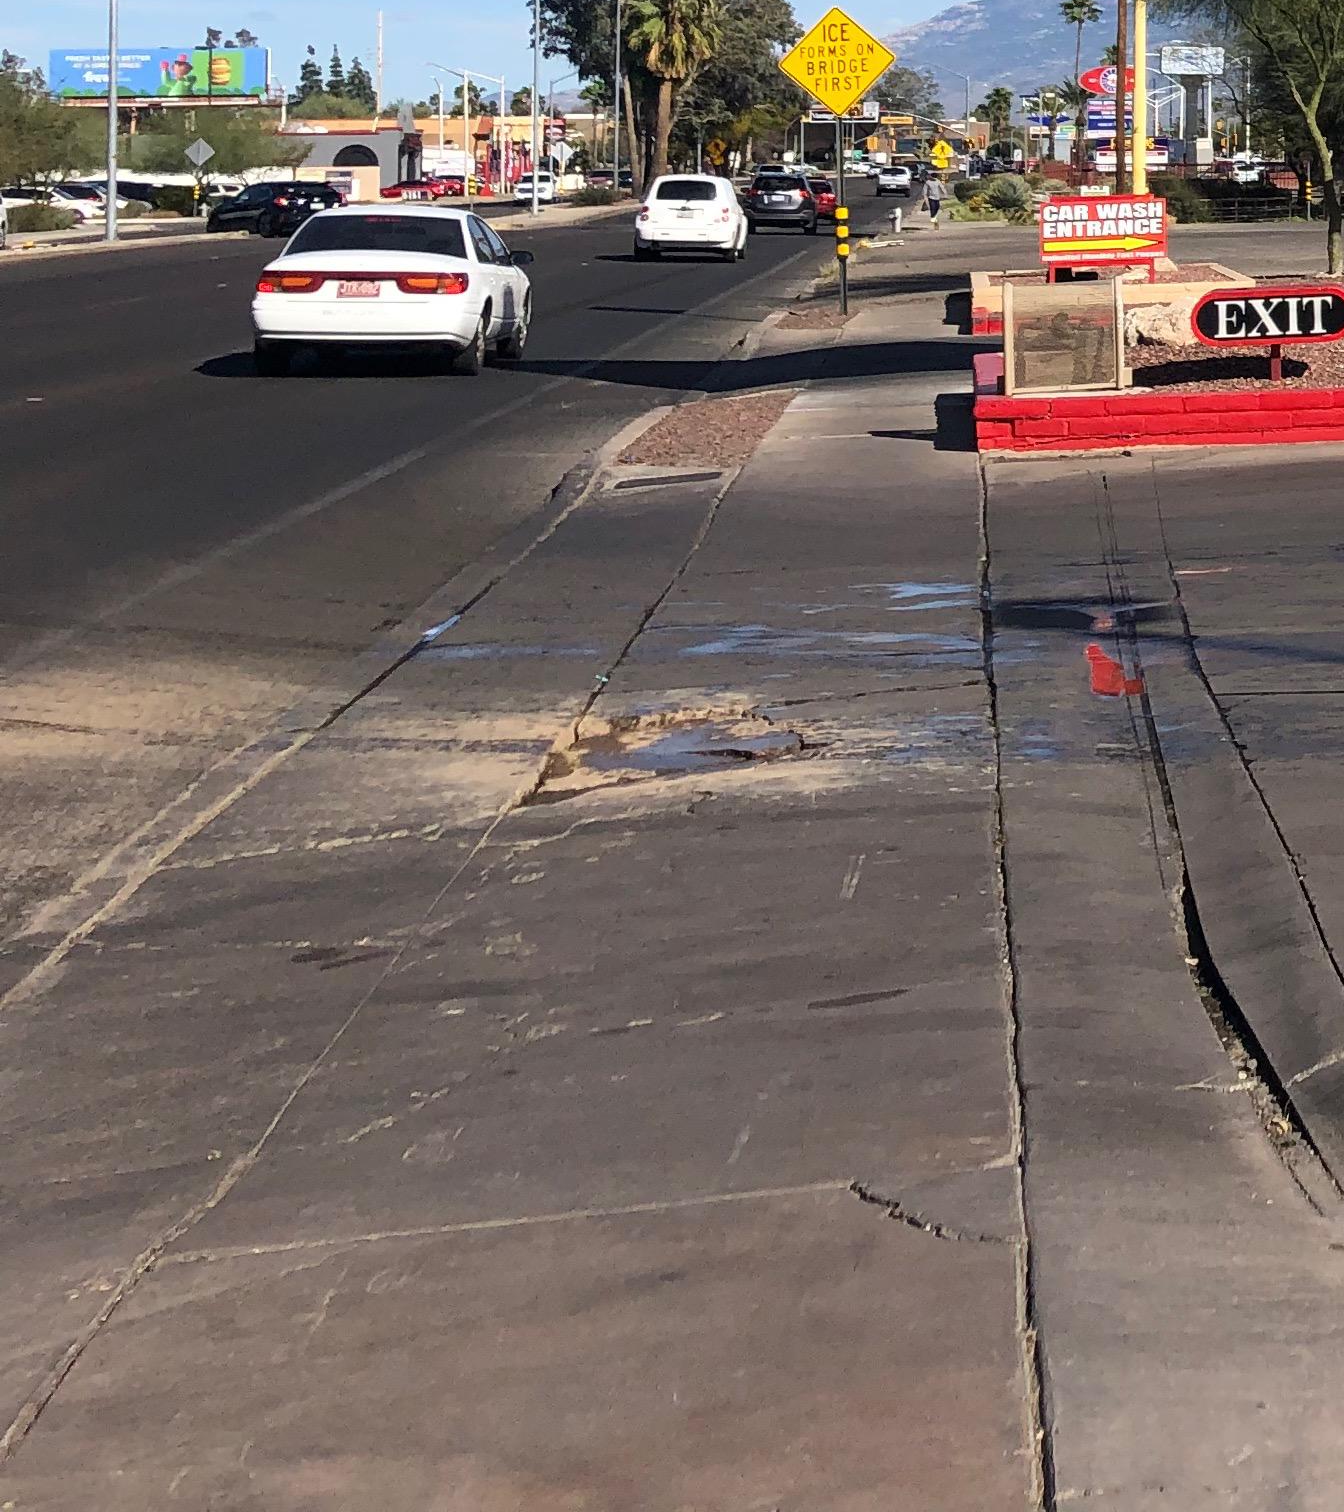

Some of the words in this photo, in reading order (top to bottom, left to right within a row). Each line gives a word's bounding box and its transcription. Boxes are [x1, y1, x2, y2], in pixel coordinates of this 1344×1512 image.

[822, 23, 850, 43] ICE
[800, 45, 846, 59] FORMS
[856, 43, 875, 56] ON
[807, 58, 869, 76] BRIDGE
[815, 76, 862, 92] FIRST
[1042, 205, 1089, 222] CAR
[1096, 202, 1163, 219] WASH
[1042, 218, 1163, 239] ENTRANCE
[1213, 294, 1335, 340] EXIT
